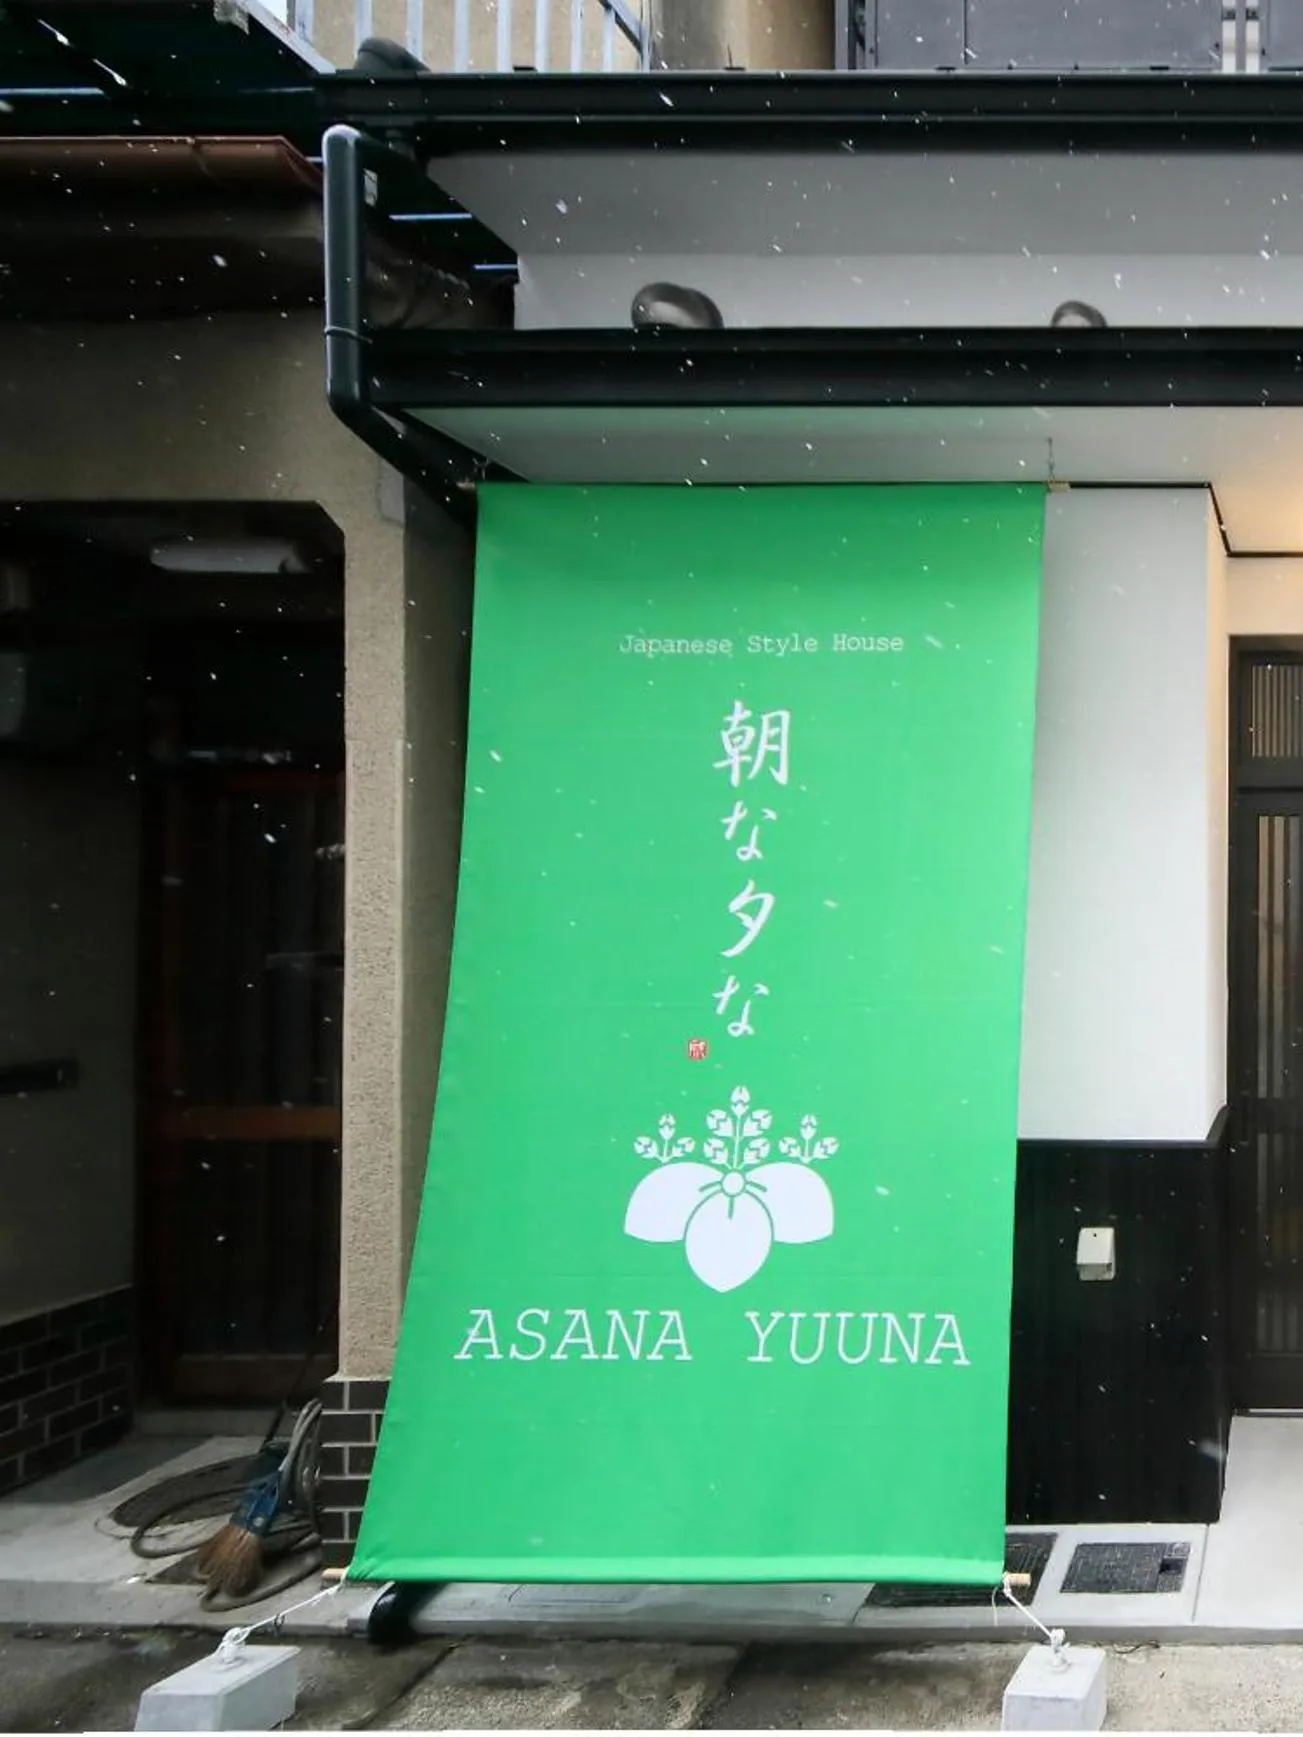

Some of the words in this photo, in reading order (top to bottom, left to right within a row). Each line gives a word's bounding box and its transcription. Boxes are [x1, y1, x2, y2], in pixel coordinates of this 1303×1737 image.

[619, 634, 733, 658] Japanese
[746, 633, 818, 656] Style
[832, 633, 904, 652] House
[712, 699, 791, 1038] 朝な夕な
[454, 1308, 693, 1361] ASANA
[745, 1311, 971, 1365] YUUNA
